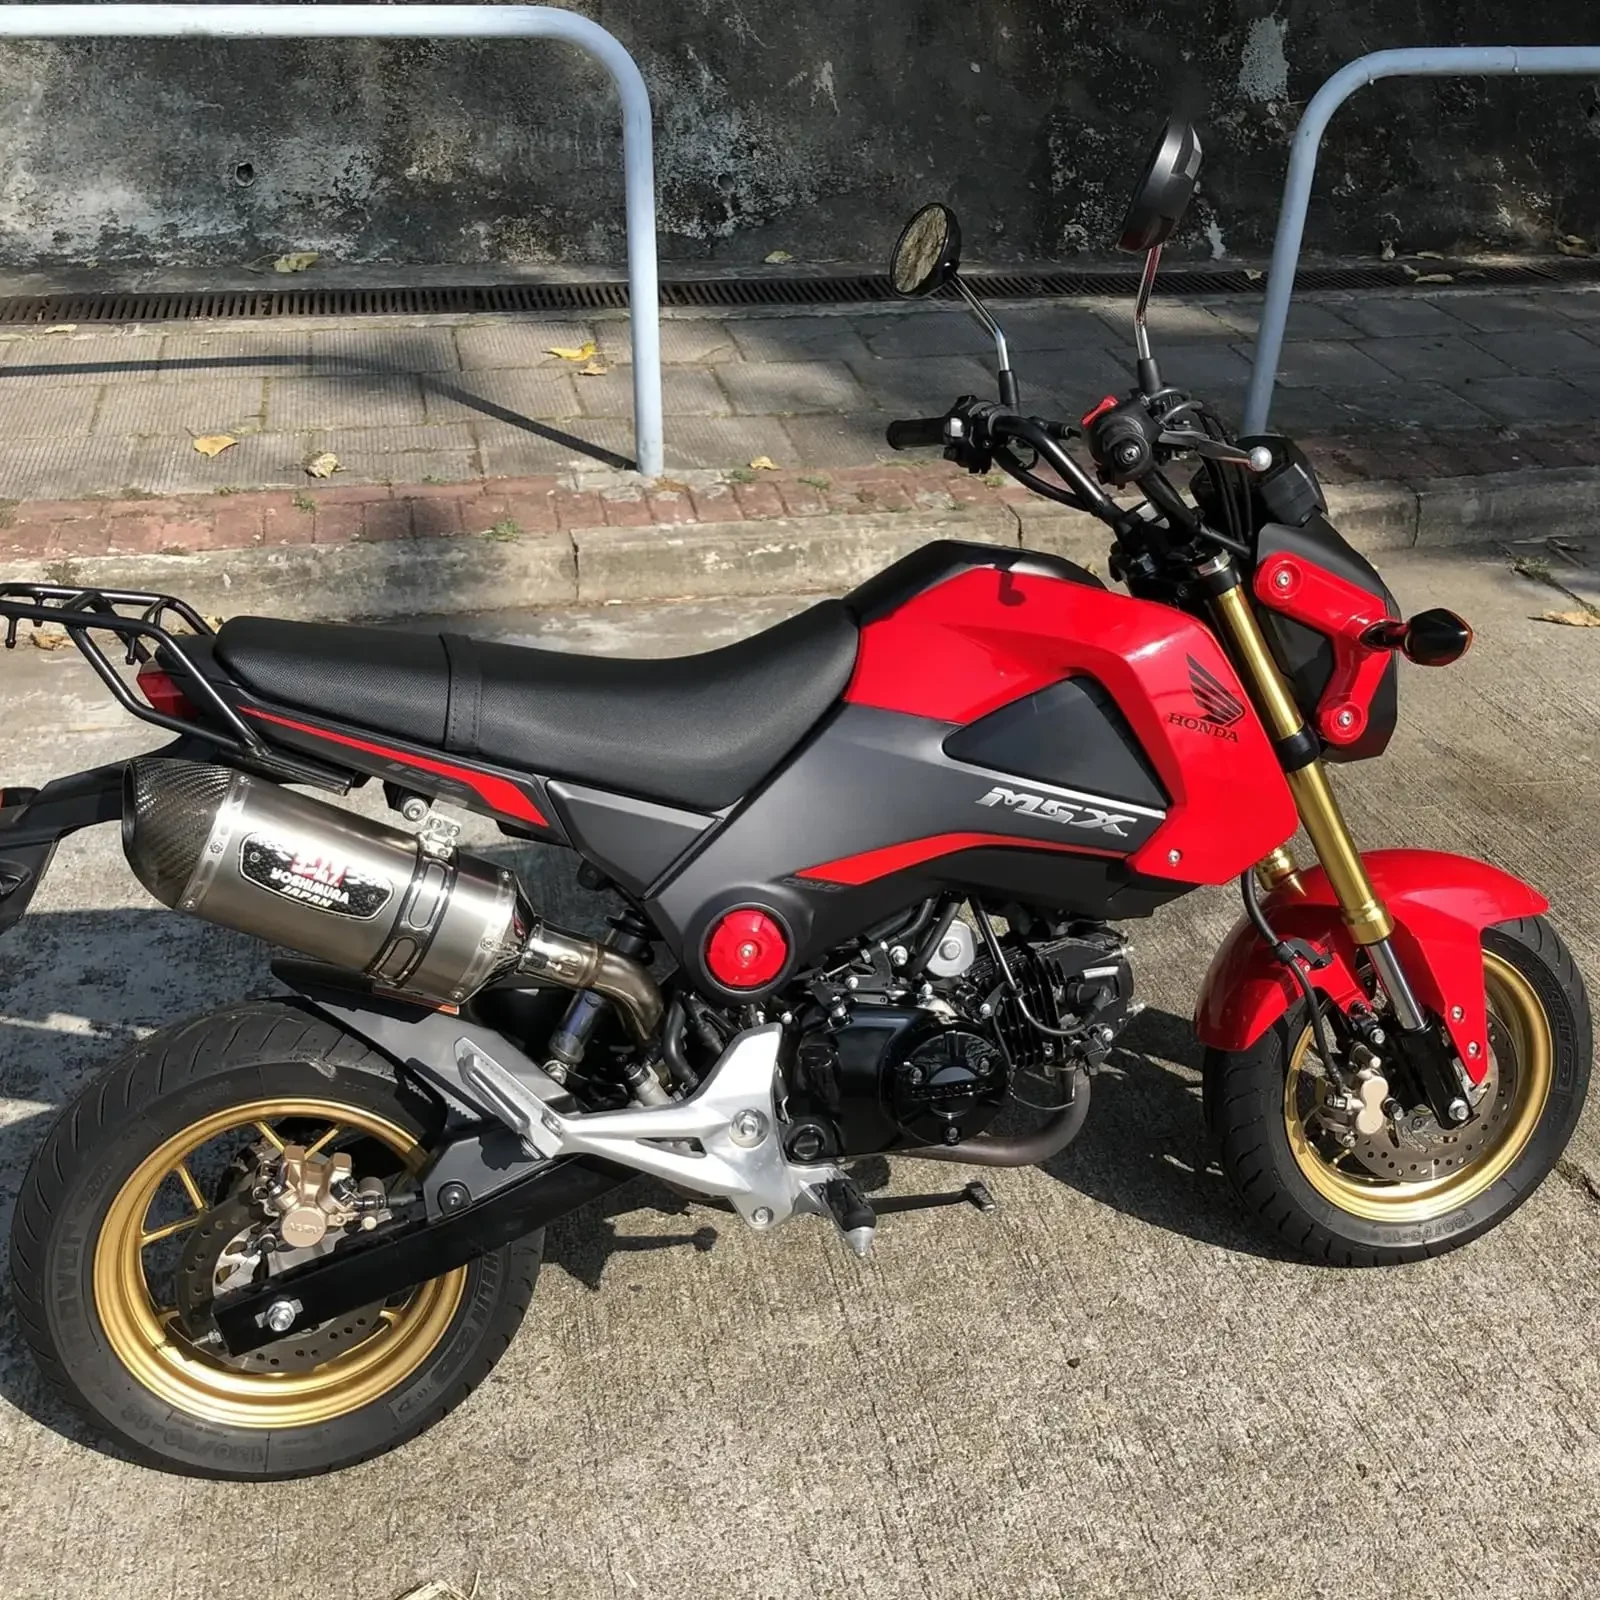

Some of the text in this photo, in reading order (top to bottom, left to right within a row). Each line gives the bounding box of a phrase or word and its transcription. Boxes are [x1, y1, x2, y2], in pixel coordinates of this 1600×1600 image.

[1168, 712, 1239, 743] HONDA
[975, 786, 1138, 838] MSX
[269, 867, 350, 904] YOSHIMURA
[279, 885, 333, 908] JAPAN
